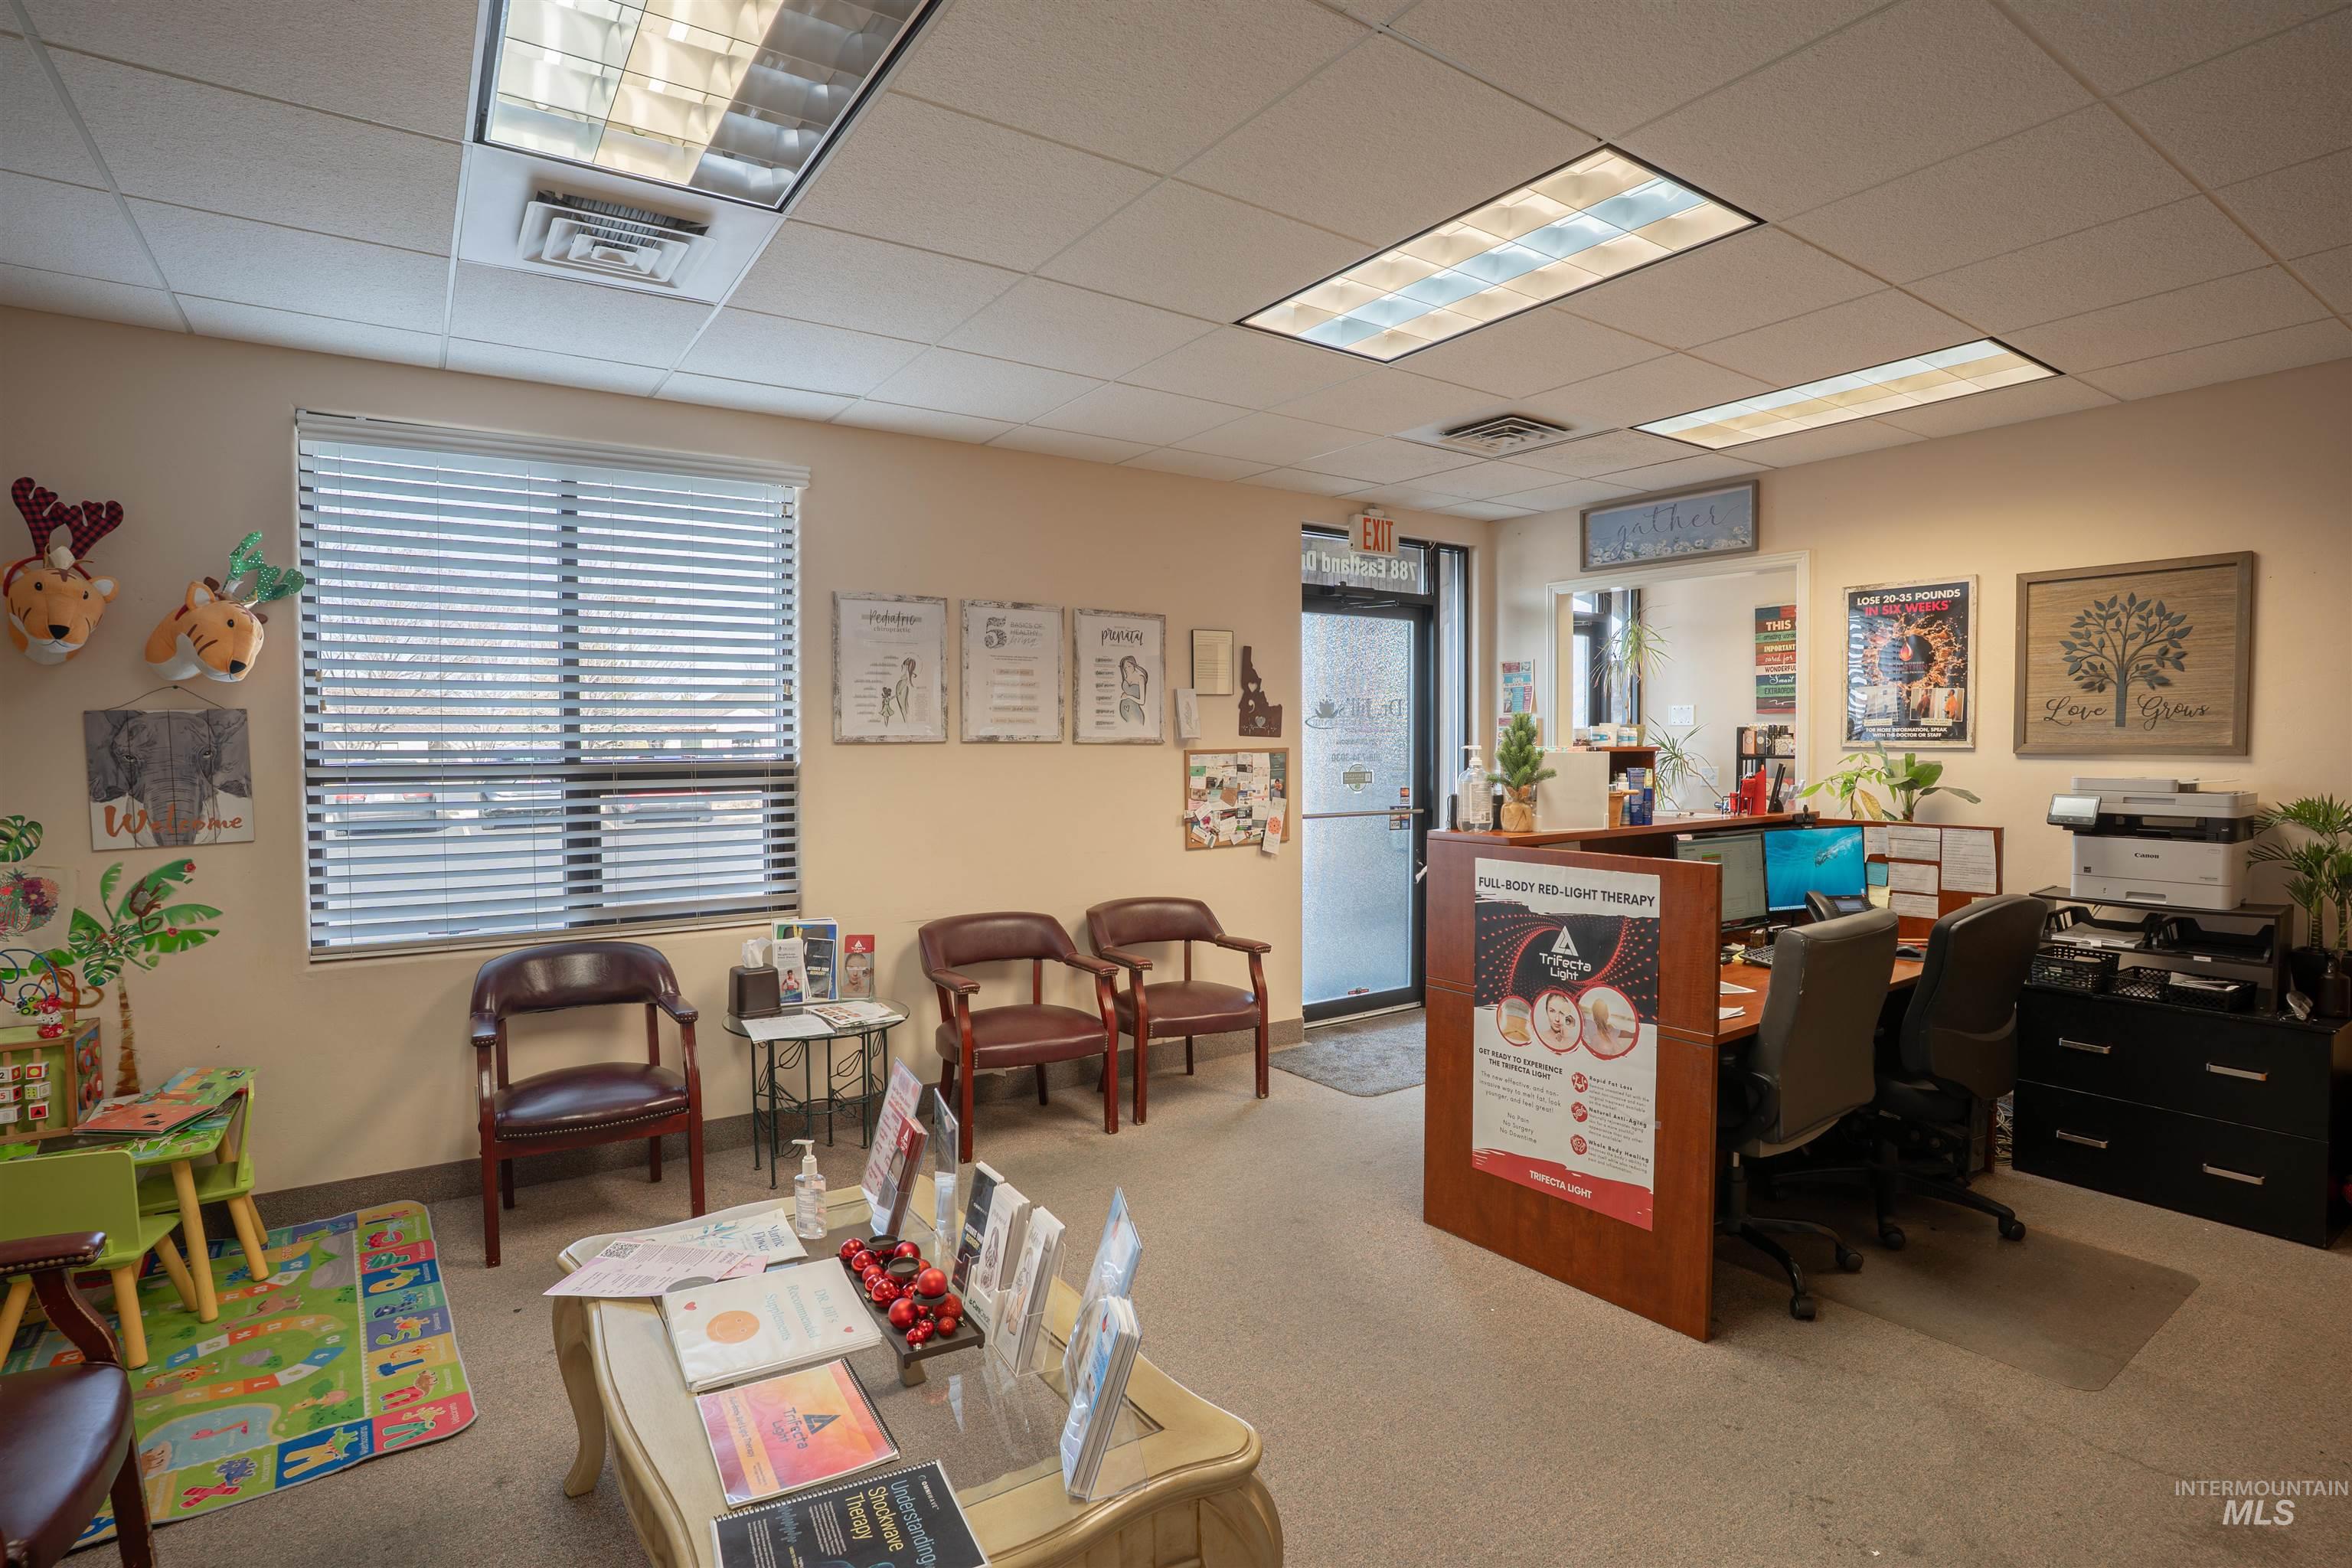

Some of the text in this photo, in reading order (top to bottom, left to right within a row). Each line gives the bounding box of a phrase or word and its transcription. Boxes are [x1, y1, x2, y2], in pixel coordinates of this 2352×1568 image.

[1363, 517, 1393, 552] EXIT
[1609, 503, 1740, 560] gather
[1857, 589, 1961, 606] LOSE 20-35 POUNDS
[1864, 606, 1878, 616] IN
[1882, 605, 1902, 615] SIX
[984, 616, 1007, 649] 5
[1766, 619, 1792, 632] THIS
[1764, 644, 1795, 653] IMPORTANT
[1765, 653, 1793, 665] cared for
[1764, 665, 1796, 673] WONDERFUL
[1769, 674, 1795, 684] Smart
[2043, 694, 2210, 731] Love Grows
[103, 804, 243, 838] Welcome
[1478, 877, 1655, 907] FULL-BODY RED-LIGHT THERAPY
[1539, 952, 1592, 972] Trifecta
[1550, 967, 1579, 982] Light
[1478, 1047, 1491, 1056] GET
[1491, 1050, 1511, 1061] READY
[1523, 1059, 1563, 1075] EXPERIENCE
[1488, 1058, 1551, 1080] THE TRIFECTA LIGHT
[1589, 1076, 1606, 1084] Rapid
[1479, 1079, 1501, 1089] invasive
[1522, 1091, 1535, 1099] melt
[1548, 1097, 1561, 1107] look
[1485, 1089, 1554, 1113] younger, and feel great!
[1503, 1119, 1534, 1135] No Surgery
[1517, 1115, 1530, 1124] Pain
[1589, 1107, 1648, 1129] Natural Anti-Aging
[1499, 1126, 1537, 1144] No Downtime
[1588, 1139, 1649, 1164] Whole Body Healing
[1529, 1170, 1592, 1199] TRIFECTA LIGHT
[753, 1230, 770, 1252] Flower
[769, 1224, 785, 1249] Marine
[765, 1292, 792, 1341] Supplements
[786, 1284, 822, 1339] Recommended
[235, 1329, 253, 1340] 14
[325, 1334, 341, 1345] 10
[772, 1420, 789, 1444] Light
[782, 1406, 808, 1450] Trifecta
[845, 1491, 874, 1541] Therapy
[867, 1485, 904, 1553] Shockwave
[890, 1480, 937, 1568] Understanding
